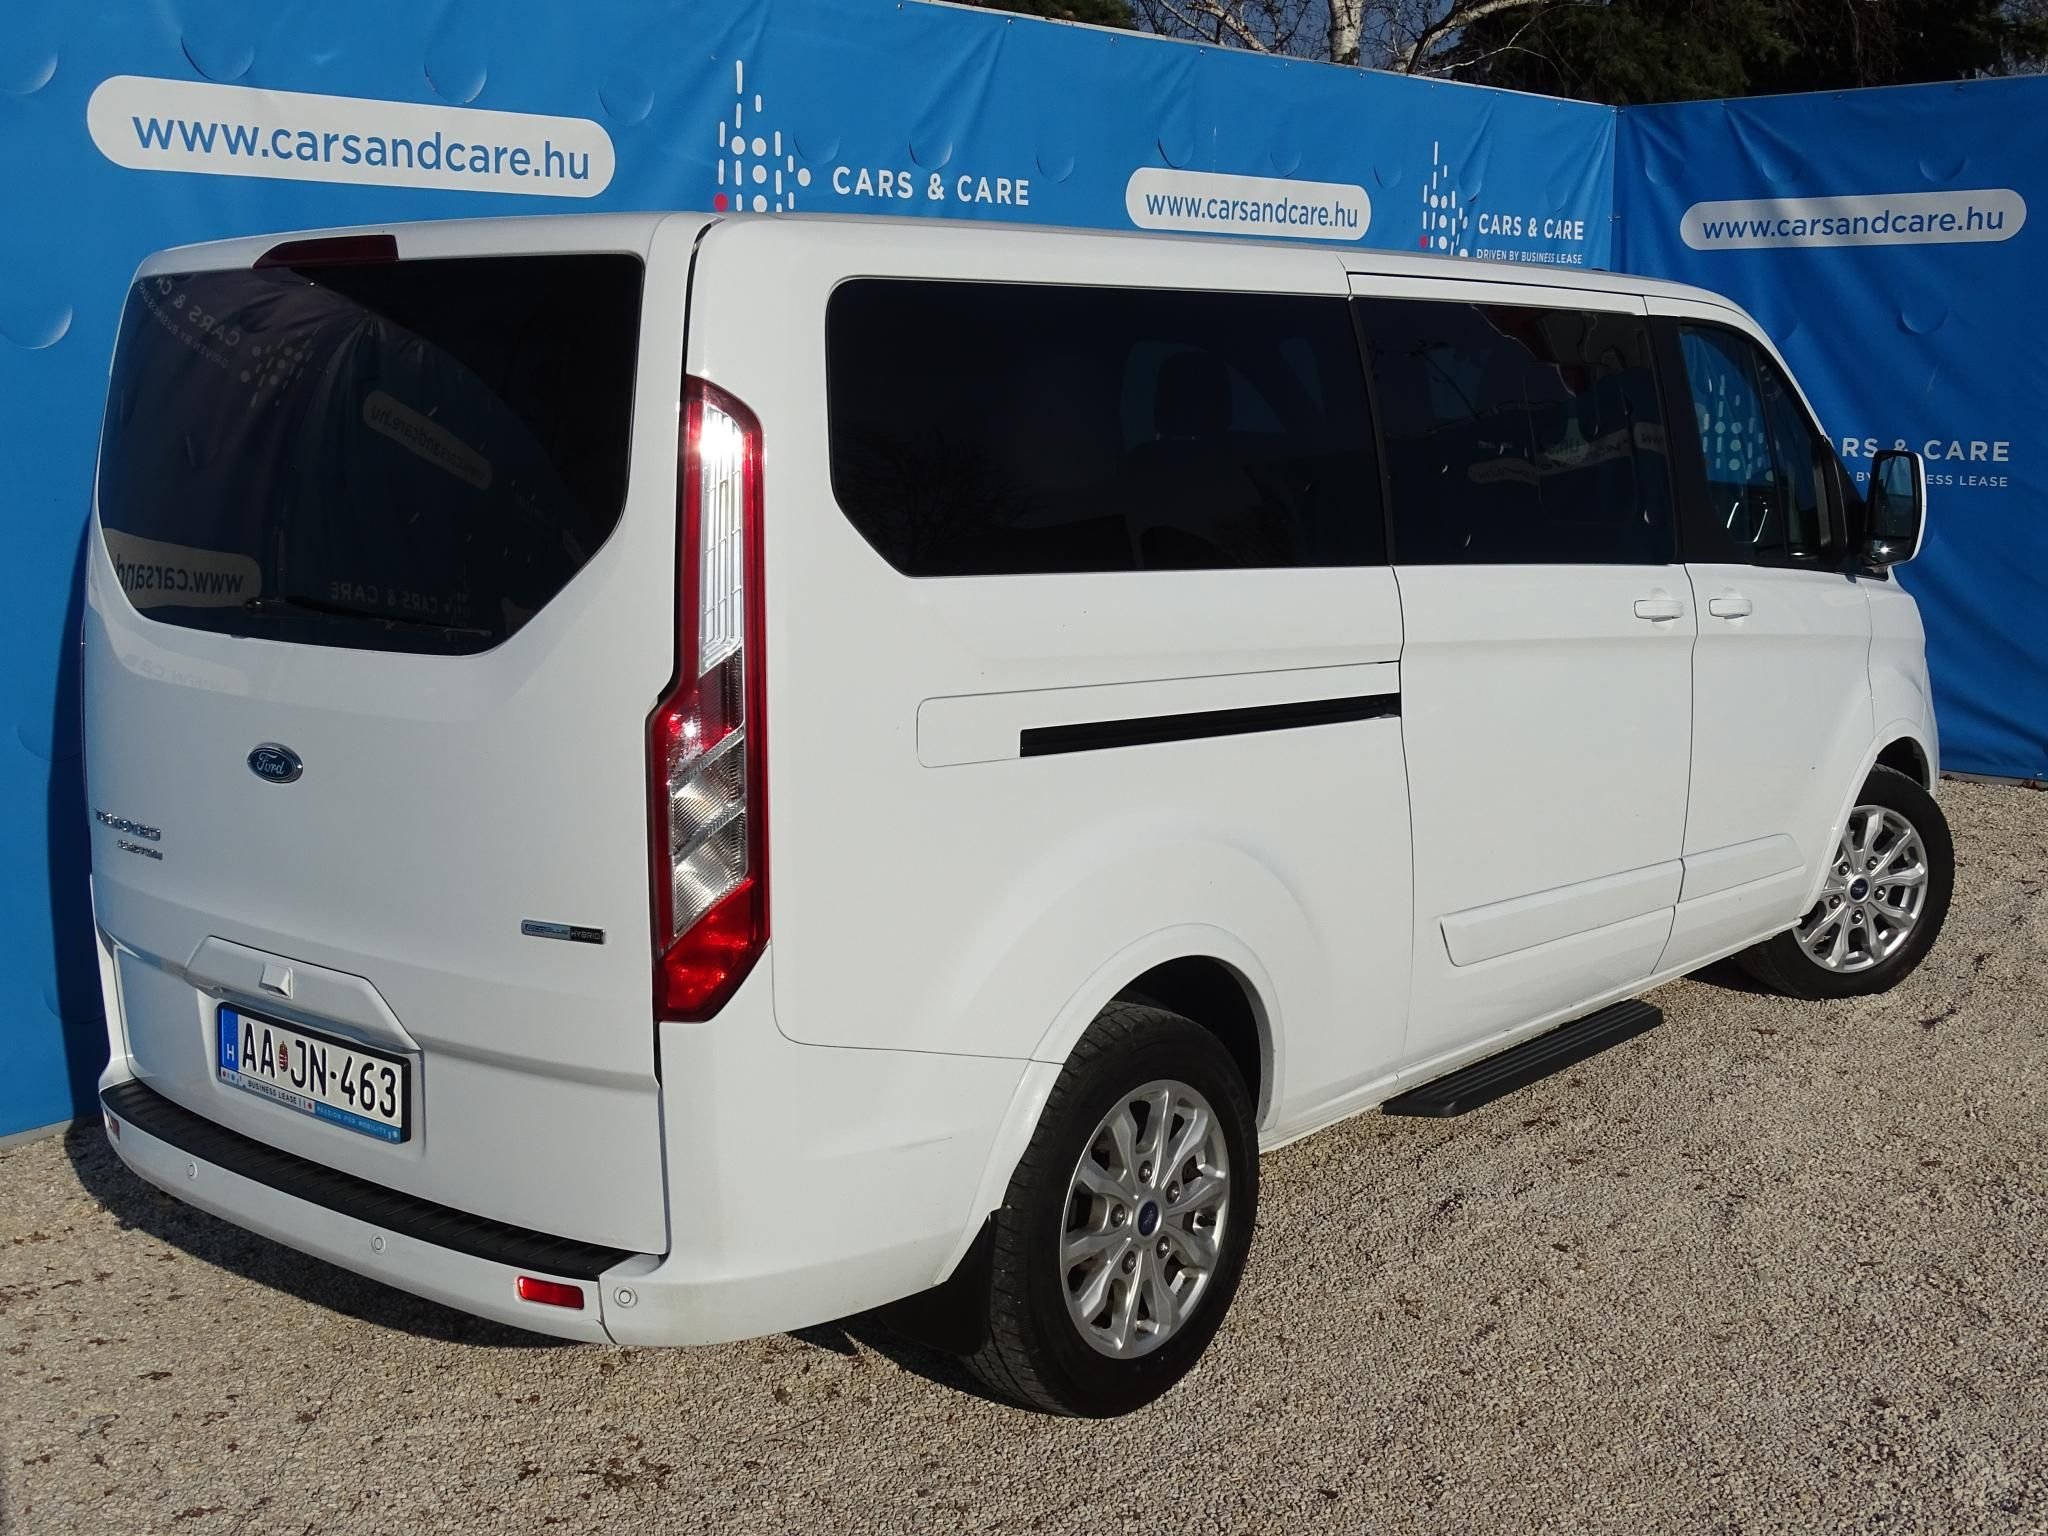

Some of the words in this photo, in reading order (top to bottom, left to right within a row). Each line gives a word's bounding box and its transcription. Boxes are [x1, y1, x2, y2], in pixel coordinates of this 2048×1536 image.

[132, 116, 590, 180] www.carsandcare.hu
[832, 165, 912, 200] CARS
[927, 172, 945, 202] &
[956, 173, 1030, 206] CARE
[1145, 188, 1359, 229] www.carsandcare.hu
[1478, 213, 1522, 236] CARS
[1527, 217, 1538, 237] &
[1543, 218, 1584, 240] CARE
[1702, 206, 2004, 240] www.carsandcare.hu
[1476, 248, 1507, 261] DRIVEN
[1509, 250, 1520, 261] BY
[1521, 251, 1555, 263] BUSINESS
[1556, 253, 1583, 264] LEASE
[1923, 439, 2010, 462] CARE
[1959, 475, 2008, 487] LEASE
[570, 928, 601, 940] HYBRID
[226, 1043, 235, 1062] H
[243, 1023, 276, 1078] AA
[247, 1078, 277, 1098] BUSINESS
[278, 1091, 298, 1106] LEASE
